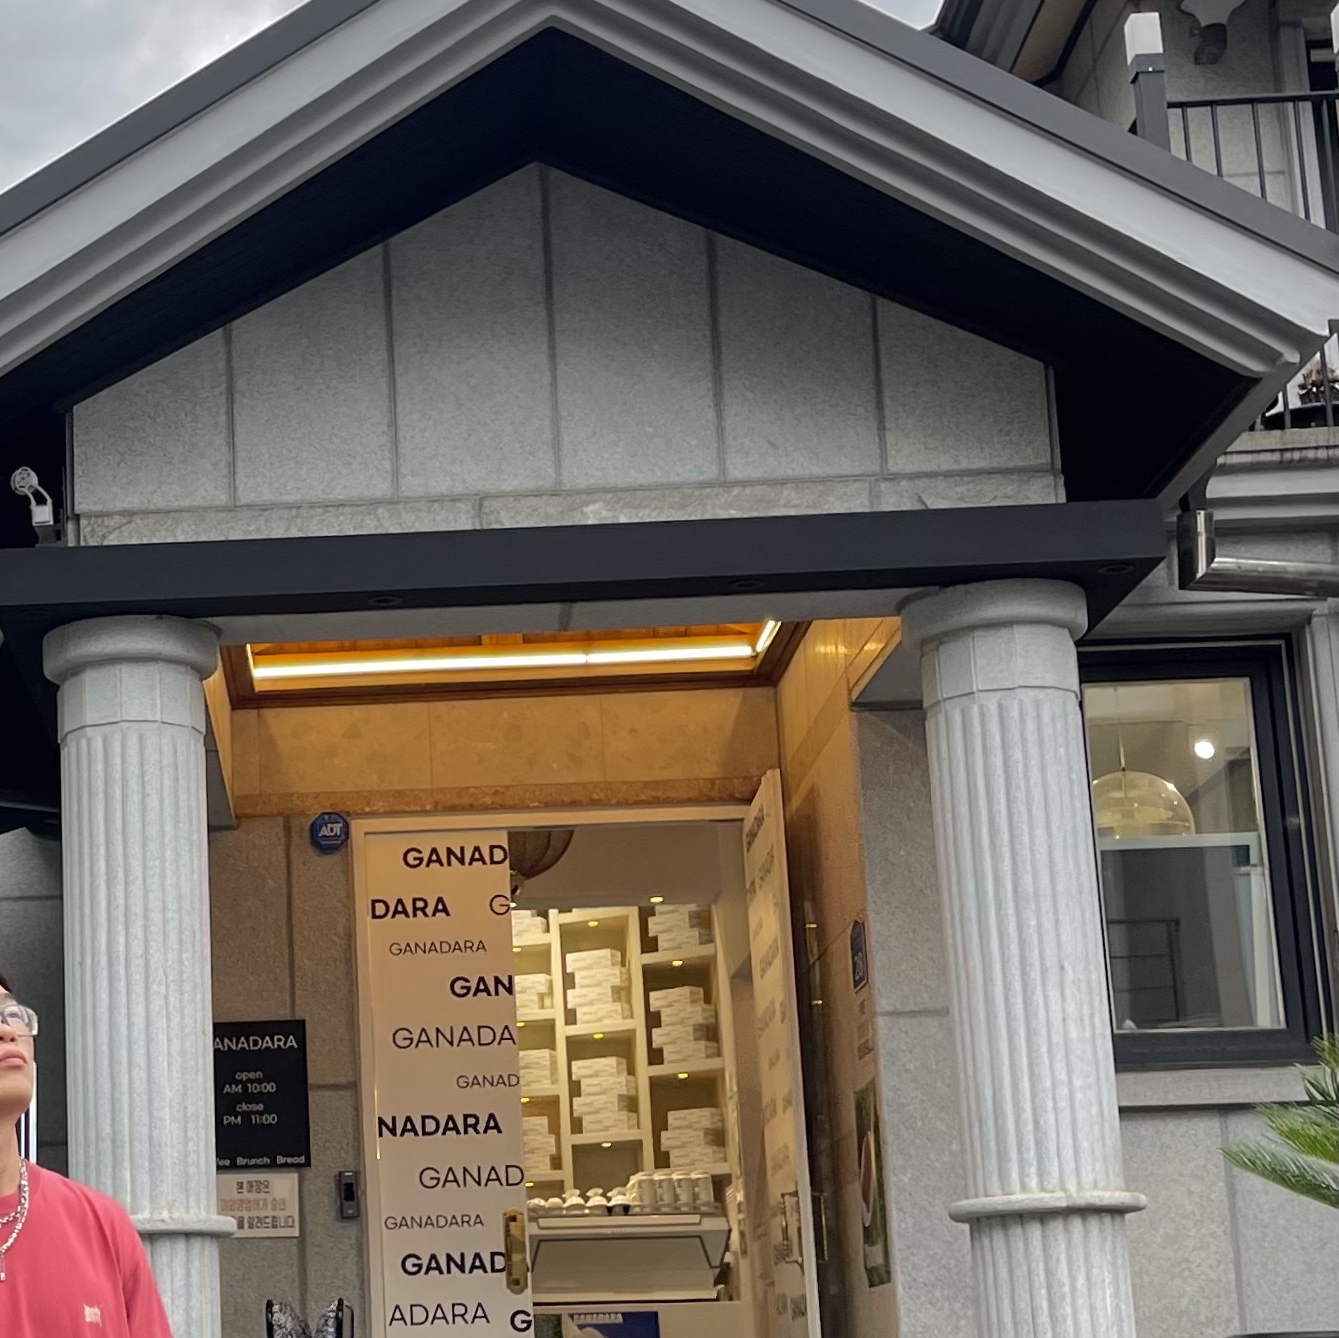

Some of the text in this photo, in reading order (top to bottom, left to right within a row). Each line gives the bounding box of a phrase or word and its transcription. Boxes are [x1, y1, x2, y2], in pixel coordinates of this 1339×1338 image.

[318, 823, 342, 837] ADT
[403, 844, 508, 869] GANAD
[371, 894, 510, 919] DARA G
[389, 939, 488, 956] GANADARA
[450, 975, 513, 998] GAN
[393, 1025, 517, 1050] GANADA
[235, 1071, 263, 1081] open
[456, 1074, 520, 1089] GANAD
[223, 1082, 277, 1094] AM 10:00
[236, 1102, 264, 1112] close
[223, 1114, 278, 1125] PM 11:00
[378, 1112, 503, 1138] NADARA
[236, 1156, 271, 1166] Brunch
[276, 1155, 305, 1164] Bread
[419, 1164, 525, 1190] GANAD
[384, 1213, 485, 1231] GANADARA
[401, 1251, 529, 1276] GANAD
[389, 1302, 533, 1333] ADARA G
